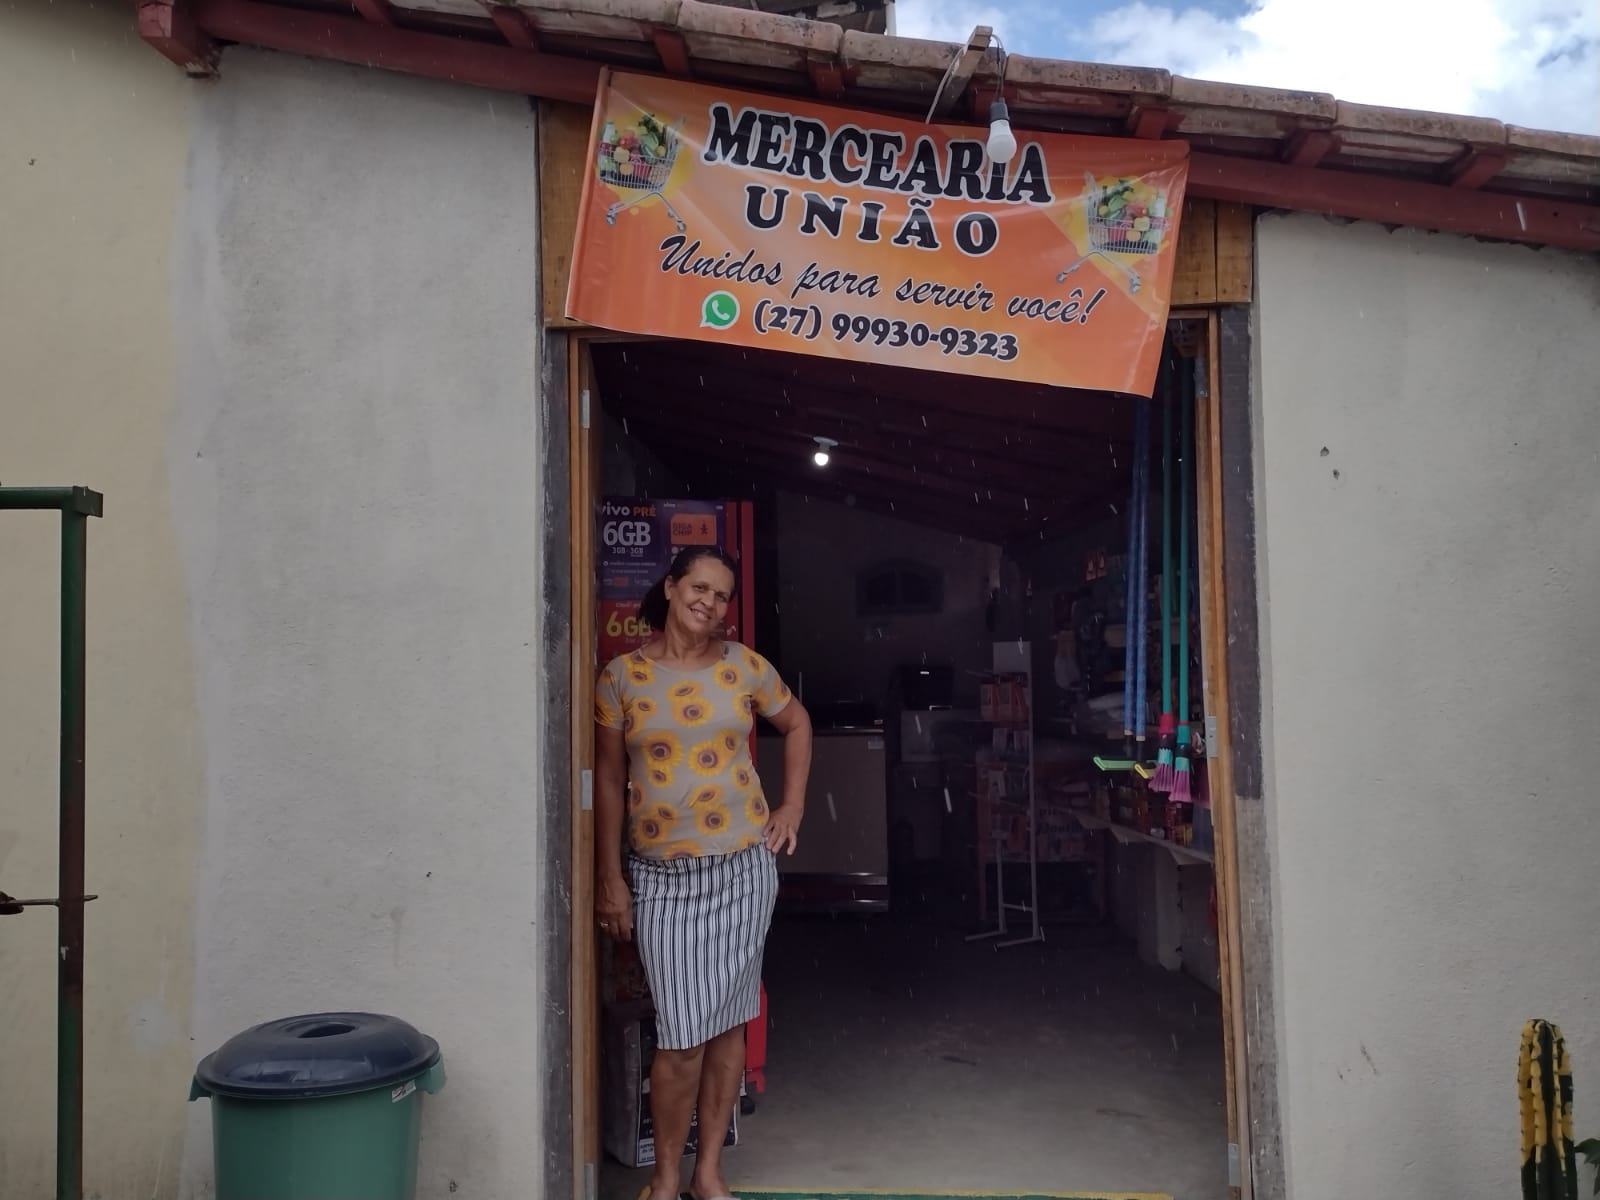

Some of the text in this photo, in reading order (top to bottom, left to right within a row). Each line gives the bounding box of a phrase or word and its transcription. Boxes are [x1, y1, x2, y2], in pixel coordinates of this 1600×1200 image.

[703, 102, 1054, 205] MERCEARIA
[745, 184, 998, 256] UNIÃO
[659, 234, 1107, 325] Unidos para servir você!
[753, 298, 1019, 362] (27) 99930-9323
[603, 520, 651, 546] 6GB
